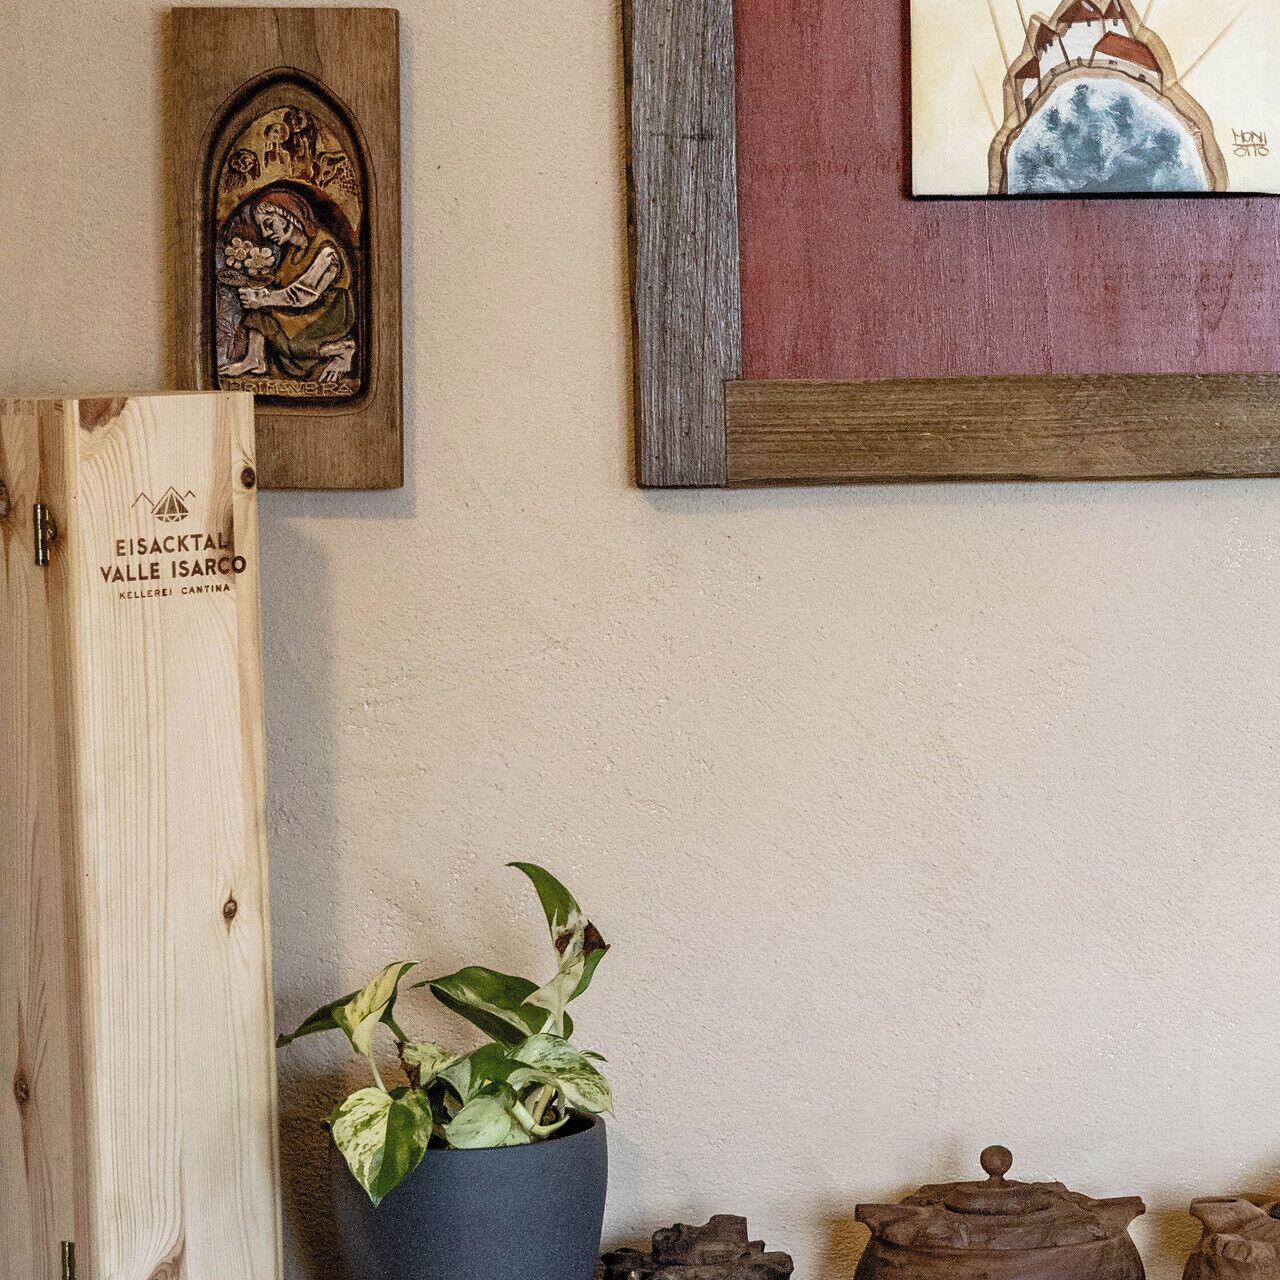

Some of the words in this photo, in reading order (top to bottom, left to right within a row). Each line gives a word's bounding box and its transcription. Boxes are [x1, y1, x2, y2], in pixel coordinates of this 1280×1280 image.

[226, 380, 354, 397] PRIMAVERA
[115, 531, 233, 557] EISACKTAL
[100, 561, 161, 584] VALLE
[171, 555, 247, 579] ISARCO
[119, 587, 173, 600] KELLEREI
[181, 583, 231, 596] CANTINA
